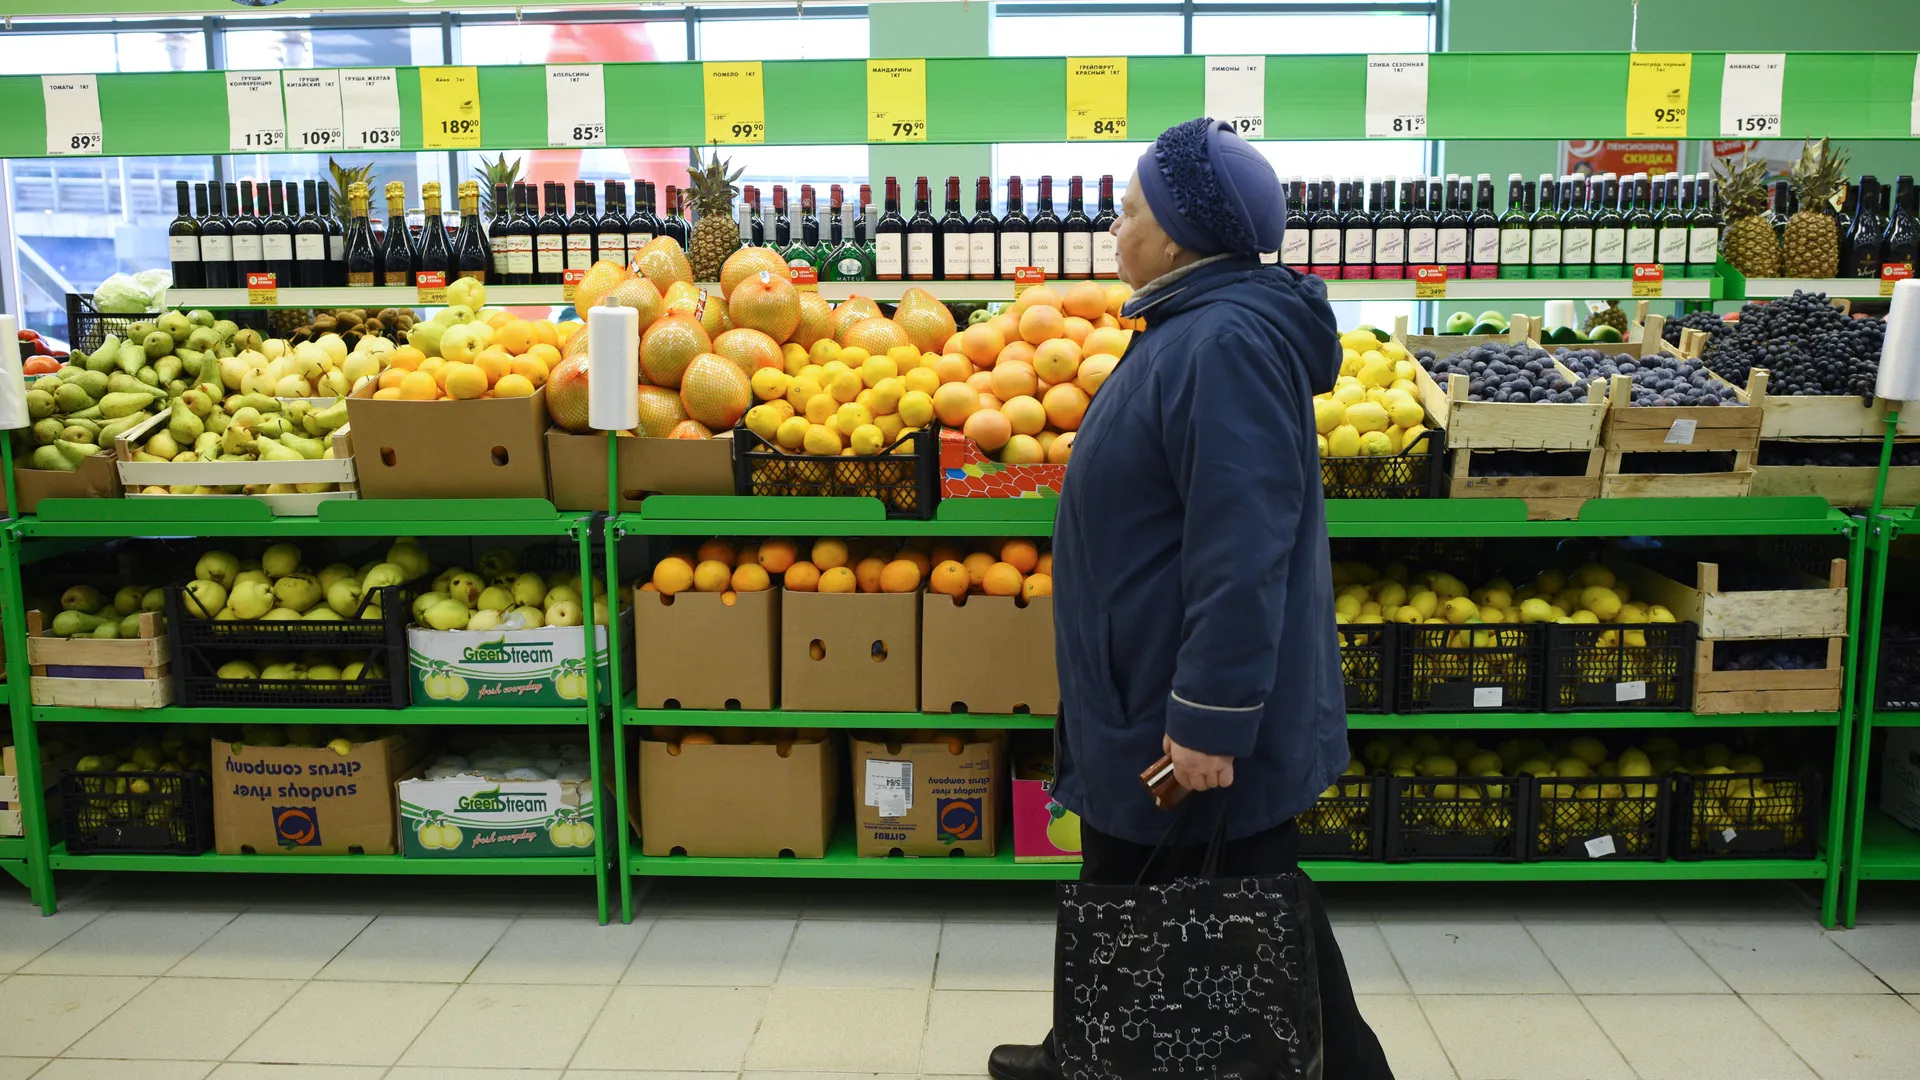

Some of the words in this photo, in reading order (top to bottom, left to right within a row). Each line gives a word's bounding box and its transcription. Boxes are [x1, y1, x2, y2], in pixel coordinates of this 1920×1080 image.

[1654, 108, 1686, 123] 95.90
[441, 119, 479, 134] 189.00
[731, 123, 764, 138] 99.90
[892, 122, 925, 137] 79.90
[1093, 120, 1126, 135] 84.90
[1392, 118, 1426, 132] 81.95
[1736, 117, 1779, 132] 159.00
[245, 132, 284, 146] 113.00
[302, 130, 341, 145] 109.00
[361, 129, 400, 144] 103.00
[572, 126, 604, 141] 85.95
[70, 135, 101, 150] 89.95
[1623, 153, 1673, 165] СКИДКА
[226, 756, 303, 775] company
[309, 761, 361, 777] citrus
[927, 776, 966, 786] company
[967, 777, 990, 786] citrus
[233, 783, 272, 801] river
[278, 782, 357, 801] sundays
[931, 788, 952, 796] river
[953, 786, 988, 796] sundays
